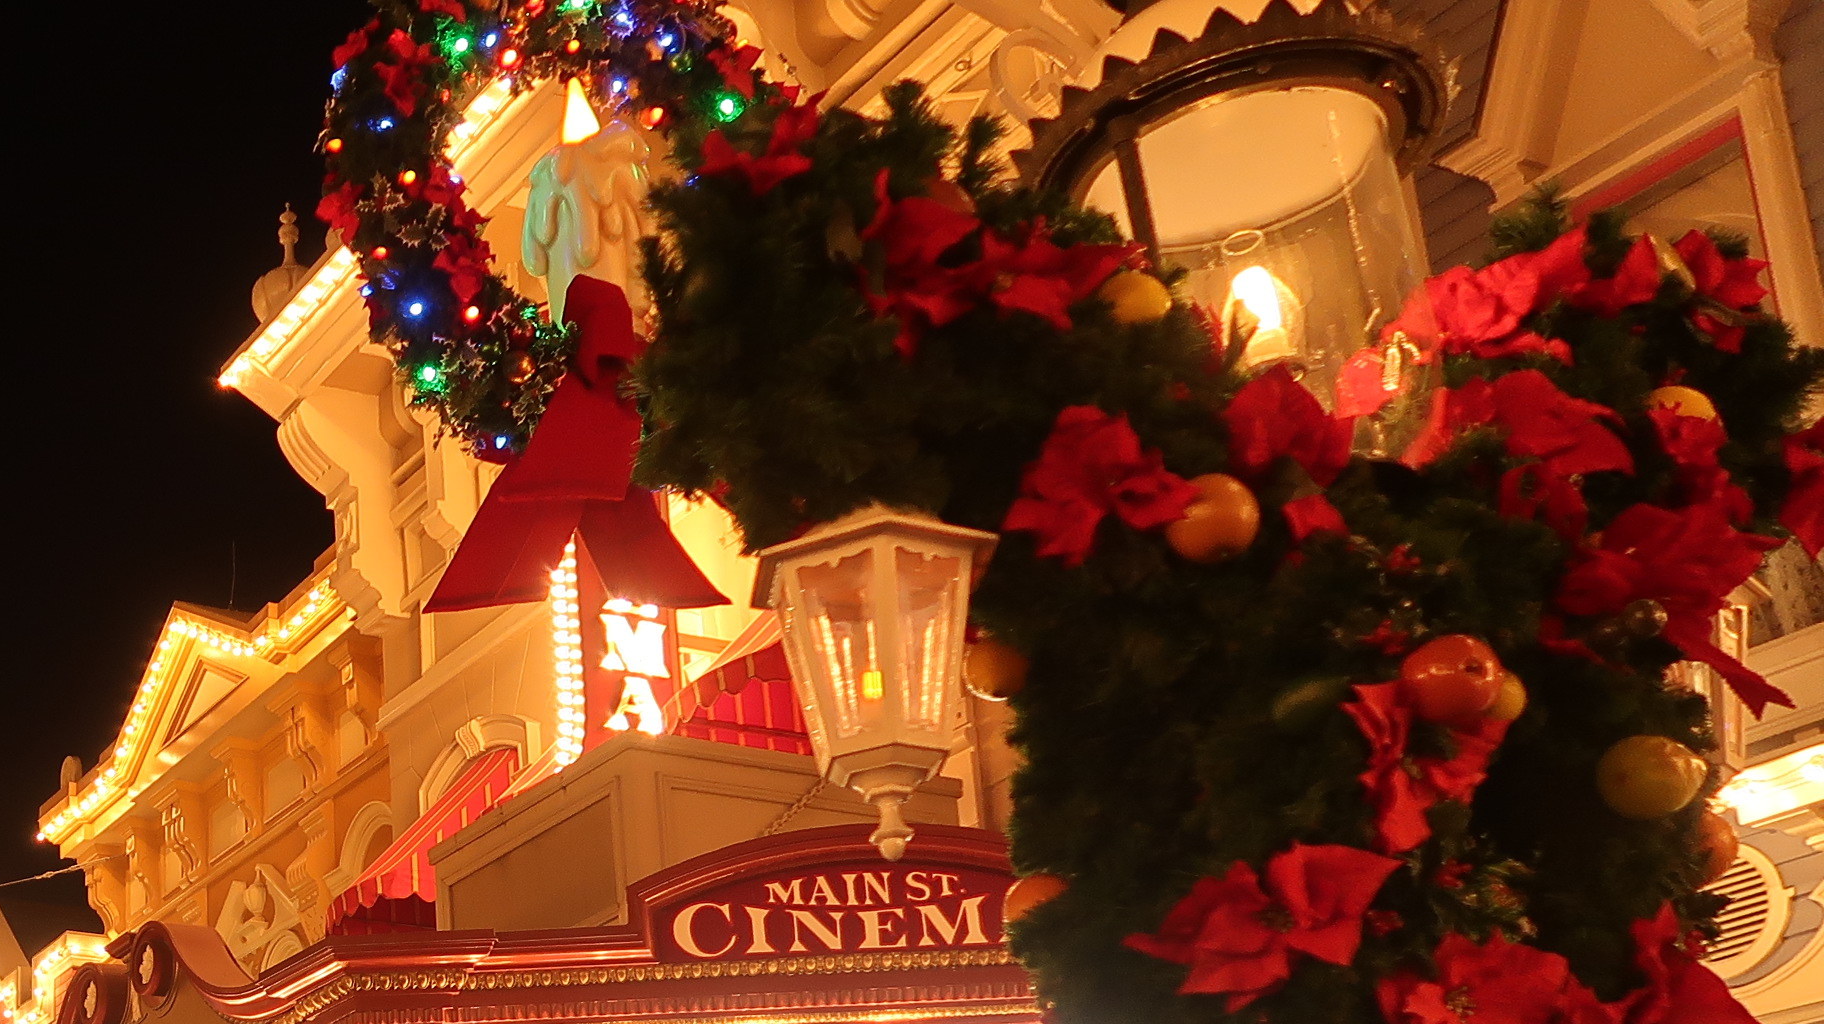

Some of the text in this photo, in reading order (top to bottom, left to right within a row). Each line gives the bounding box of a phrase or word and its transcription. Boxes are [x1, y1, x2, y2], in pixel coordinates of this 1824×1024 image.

[764, 871, 967, 907] MAIN ST.
[672, 895, 1012, 959] CINEM
